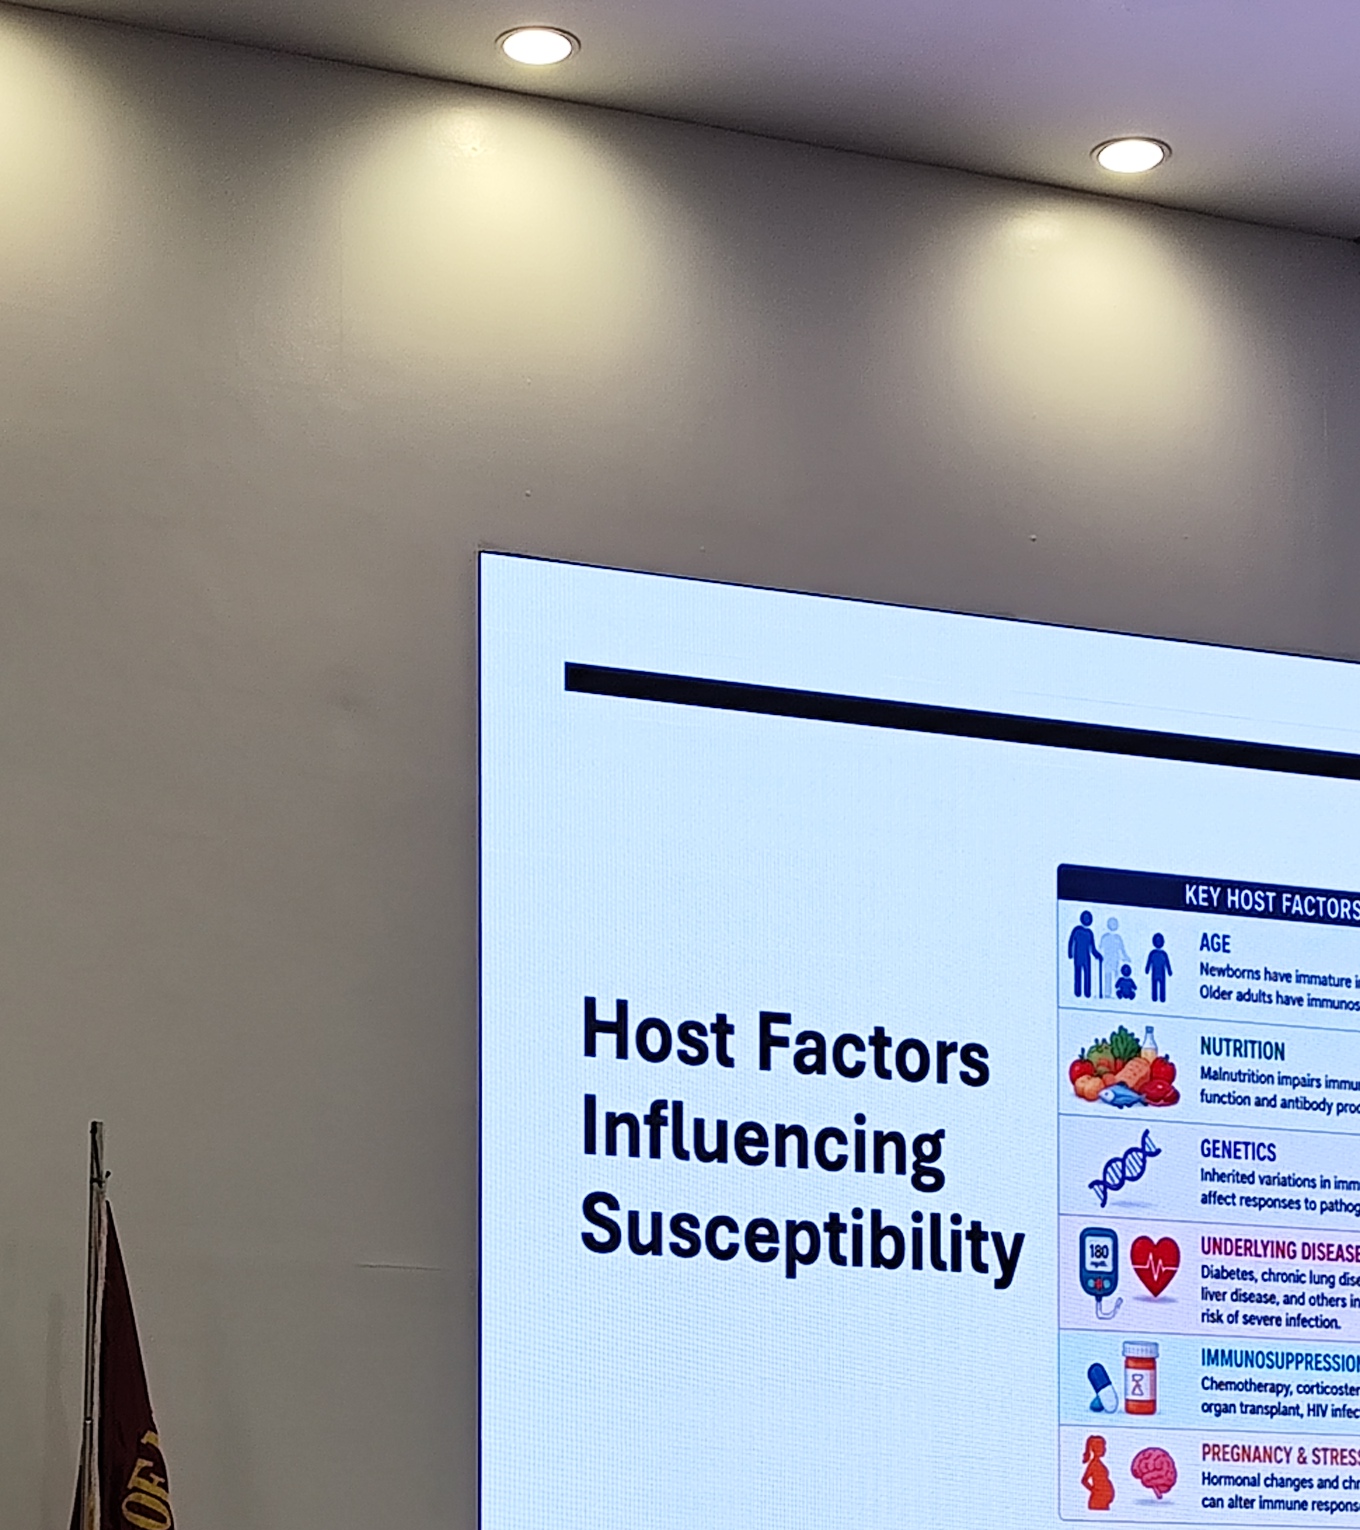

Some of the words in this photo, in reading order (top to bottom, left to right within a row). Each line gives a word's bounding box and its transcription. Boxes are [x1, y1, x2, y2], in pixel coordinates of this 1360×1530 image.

[1185, 884, 1220, 906] KEY
[1227, 888, 1276, 911] HOST
[1199, 932, 1230, 953] AGE
[1199, 961, 1260, 981] Newborns
[1264, 967, 1292, 983] have
[1295, 969, 1352, 988] immature
[1199, 984, 1233, 1000] Older
[1236, 988, 1273, 1004] adults
[1275, 990, 1304, 1007] have
[584, 995, 735, 1069] Host
[759, 1010, 990, 1088] Factors
[1200, 1036, 1285, 1061] NUTRITION
[1200, 1065, 1274, 1085] Malnutrition
[1277, 1071, 1321, 1089] impairs
[1200, 1088, 1251, 1106] function
[1254, 1094, 1277, 1108] and
[1280, 1096, 1333, 1115] antibody
[584, 1093, 946, 1193] Influencing
[1200, 1138, 1276, 1162] GENETICS
[1200, 1167, 1255, 1185] Inherited
[1258, 1172, 1317, 1189] variations
[1320, 1174, 1331, 1189] in
[1200, 1190, 1236, 1206] affect
[1239, 1195, 1301, 1211] responses
[1304, 1197, 1316, 1211] to
[581, 1191, 1026, 1290] Susceptibility
[1089, 1243, 1109, 1259] 180
[1201, 1236, 1296, 1259] UNDERLYING
[1201, 1264, 1258, 1283] Diabetes,
[1261, 1267, 1306, 1284] chronic
[1309, 1270, 1335, 1289] lung
[1201, 1286, 1227, 1301] liver
[1230, 1288, 1280, 1306] disease,
[1282, 1291, 1305, 1306] and
[1308, 1292, 1347, 1308] others
[1201, 1308, 1224, 1323] risk
[1226, 1310, 1239, 1324] of
[1242, 1313, 1282, 1327] severe
[1285, 1312, 1341, 1329] infection.
[1201, 1375, 1293, 1398] Chemotherapy,
[1201, 1402, 1236, 1417] organ
[1239, 1401, 1304, 1419] transplant,
[1307, 1403, 1328, 1417] HIV
[1202, 1443, 1292, 1464] PREGNANCY
[1297, 1446, 1307, 1464] &
[1201, 1471, 1260, 1487] Hormonal
[1263, 1472, 1314, 1492] changes
[1316, 1475, 1339, 1489] and
[1201, 1496, 1224, 1508] can
[1227, 1494, 1256, 1509] alter
[1258, 1495, 1308, 1511] immune
